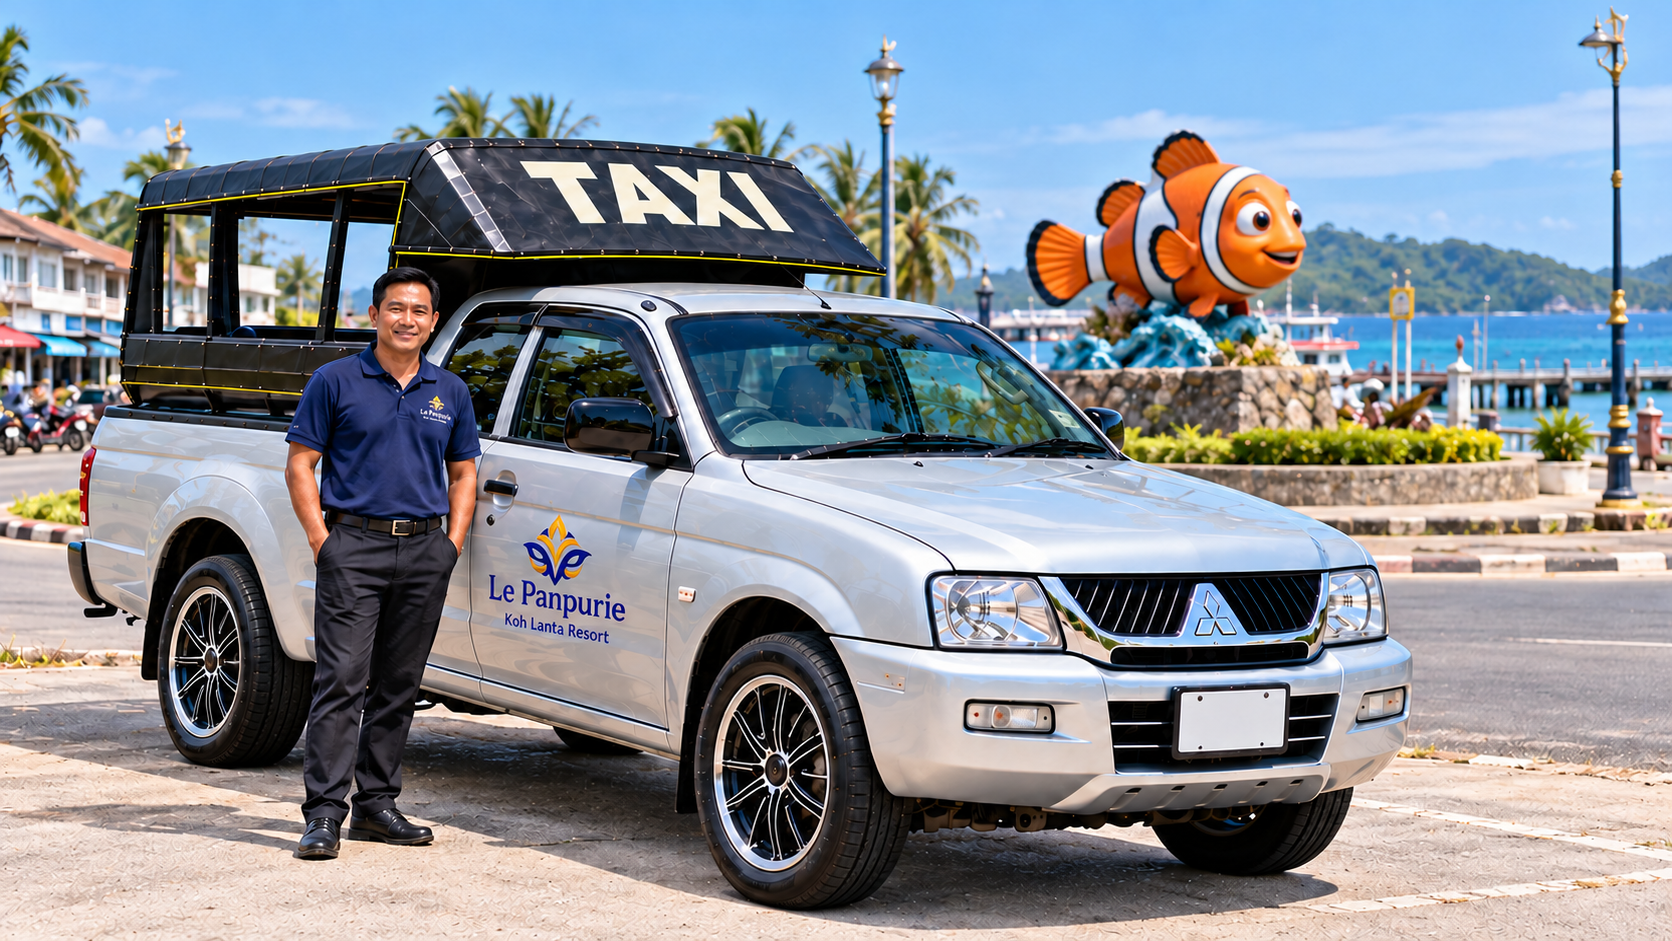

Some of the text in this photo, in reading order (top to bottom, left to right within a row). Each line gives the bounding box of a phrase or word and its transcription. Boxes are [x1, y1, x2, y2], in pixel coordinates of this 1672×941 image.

[520, 161, 794, 233] TAXI
[489, 574, 626, 622] Le Panpurie
[505, 613, 609, 644] Koh Lanta Resort
